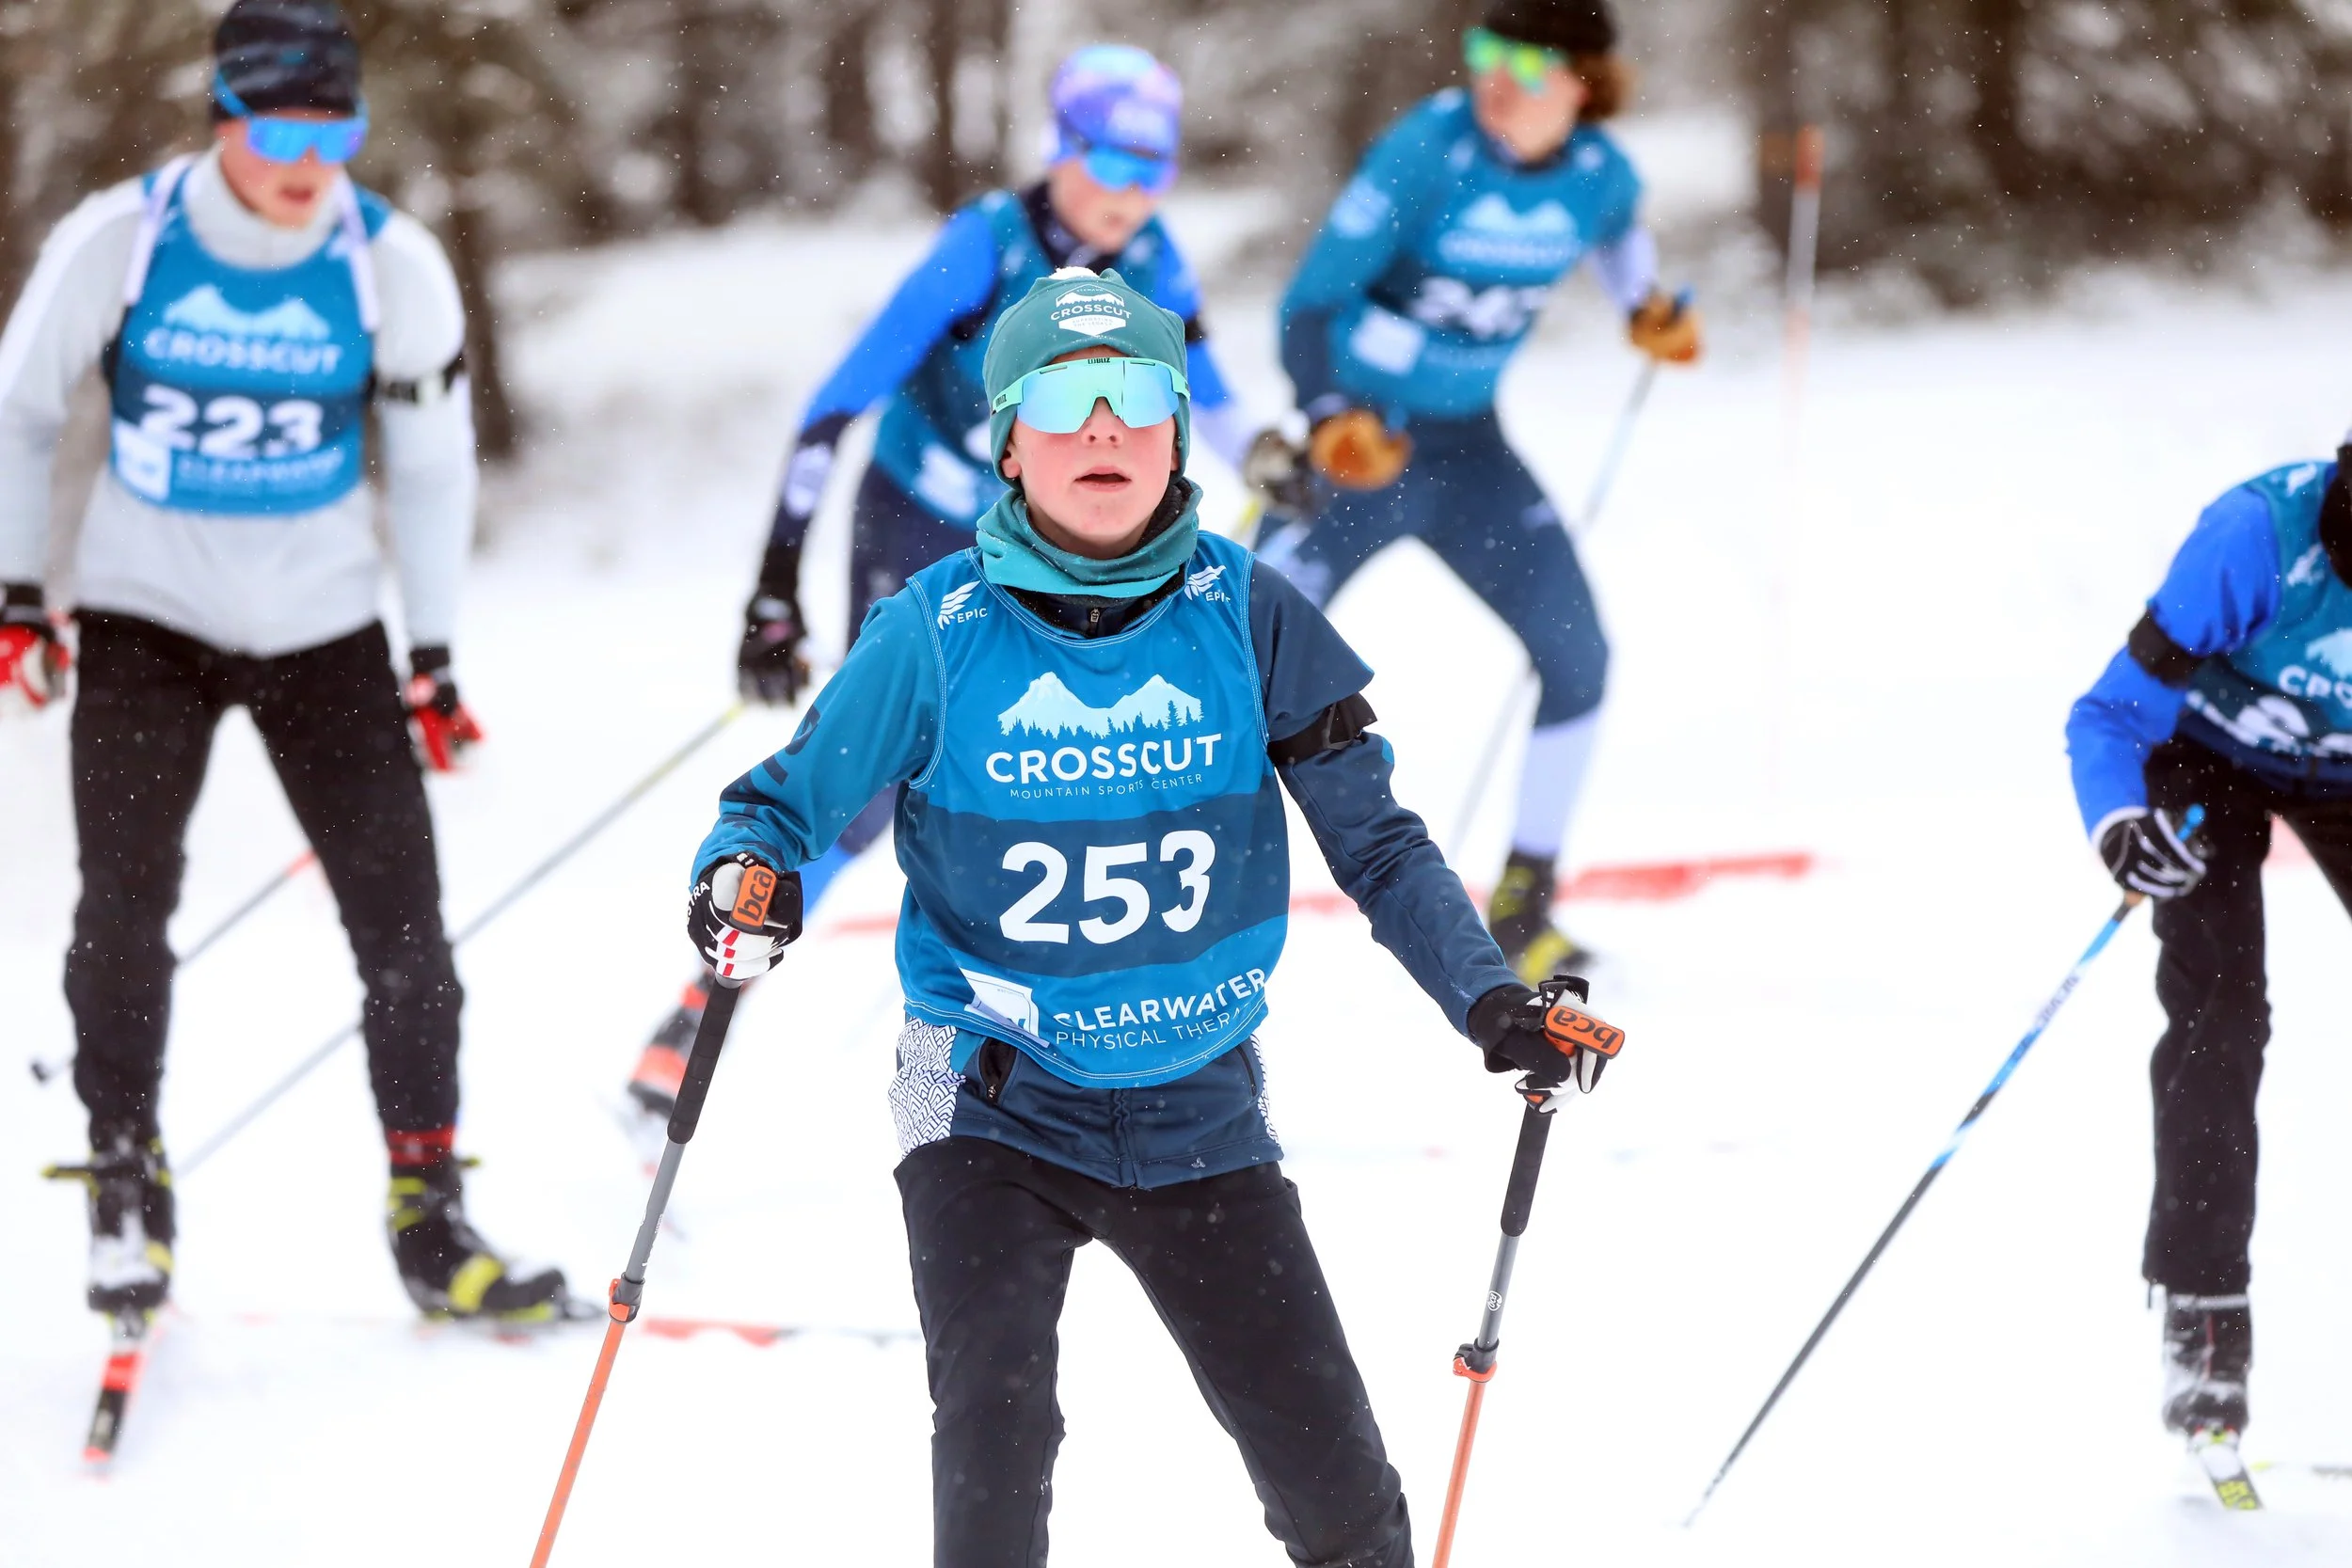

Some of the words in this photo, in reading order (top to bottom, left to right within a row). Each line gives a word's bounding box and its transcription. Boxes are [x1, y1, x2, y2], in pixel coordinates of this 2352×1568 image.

[1050, 304, 1132, 321] CROSSCUT
[145, 328, 343, 374] CROSSCUT
[140, 384, 325, 459] 223
[957, 608, 988, 624] EPIC
[985, 733, 1222, 784] CROSSCUT
[1009, 786, 1090, 800] MOUNTAIN
[1098, 779, 1144, 796] SPORTS
[1151, 772, 1203, 790] CENTER
[737, 869, 773, 923] bca
[998, 830, 1216, 945] 253
[1056, 1028, 1167, 1051] PHYSICAL
[1552, 1008, 1619, 1050] bca
